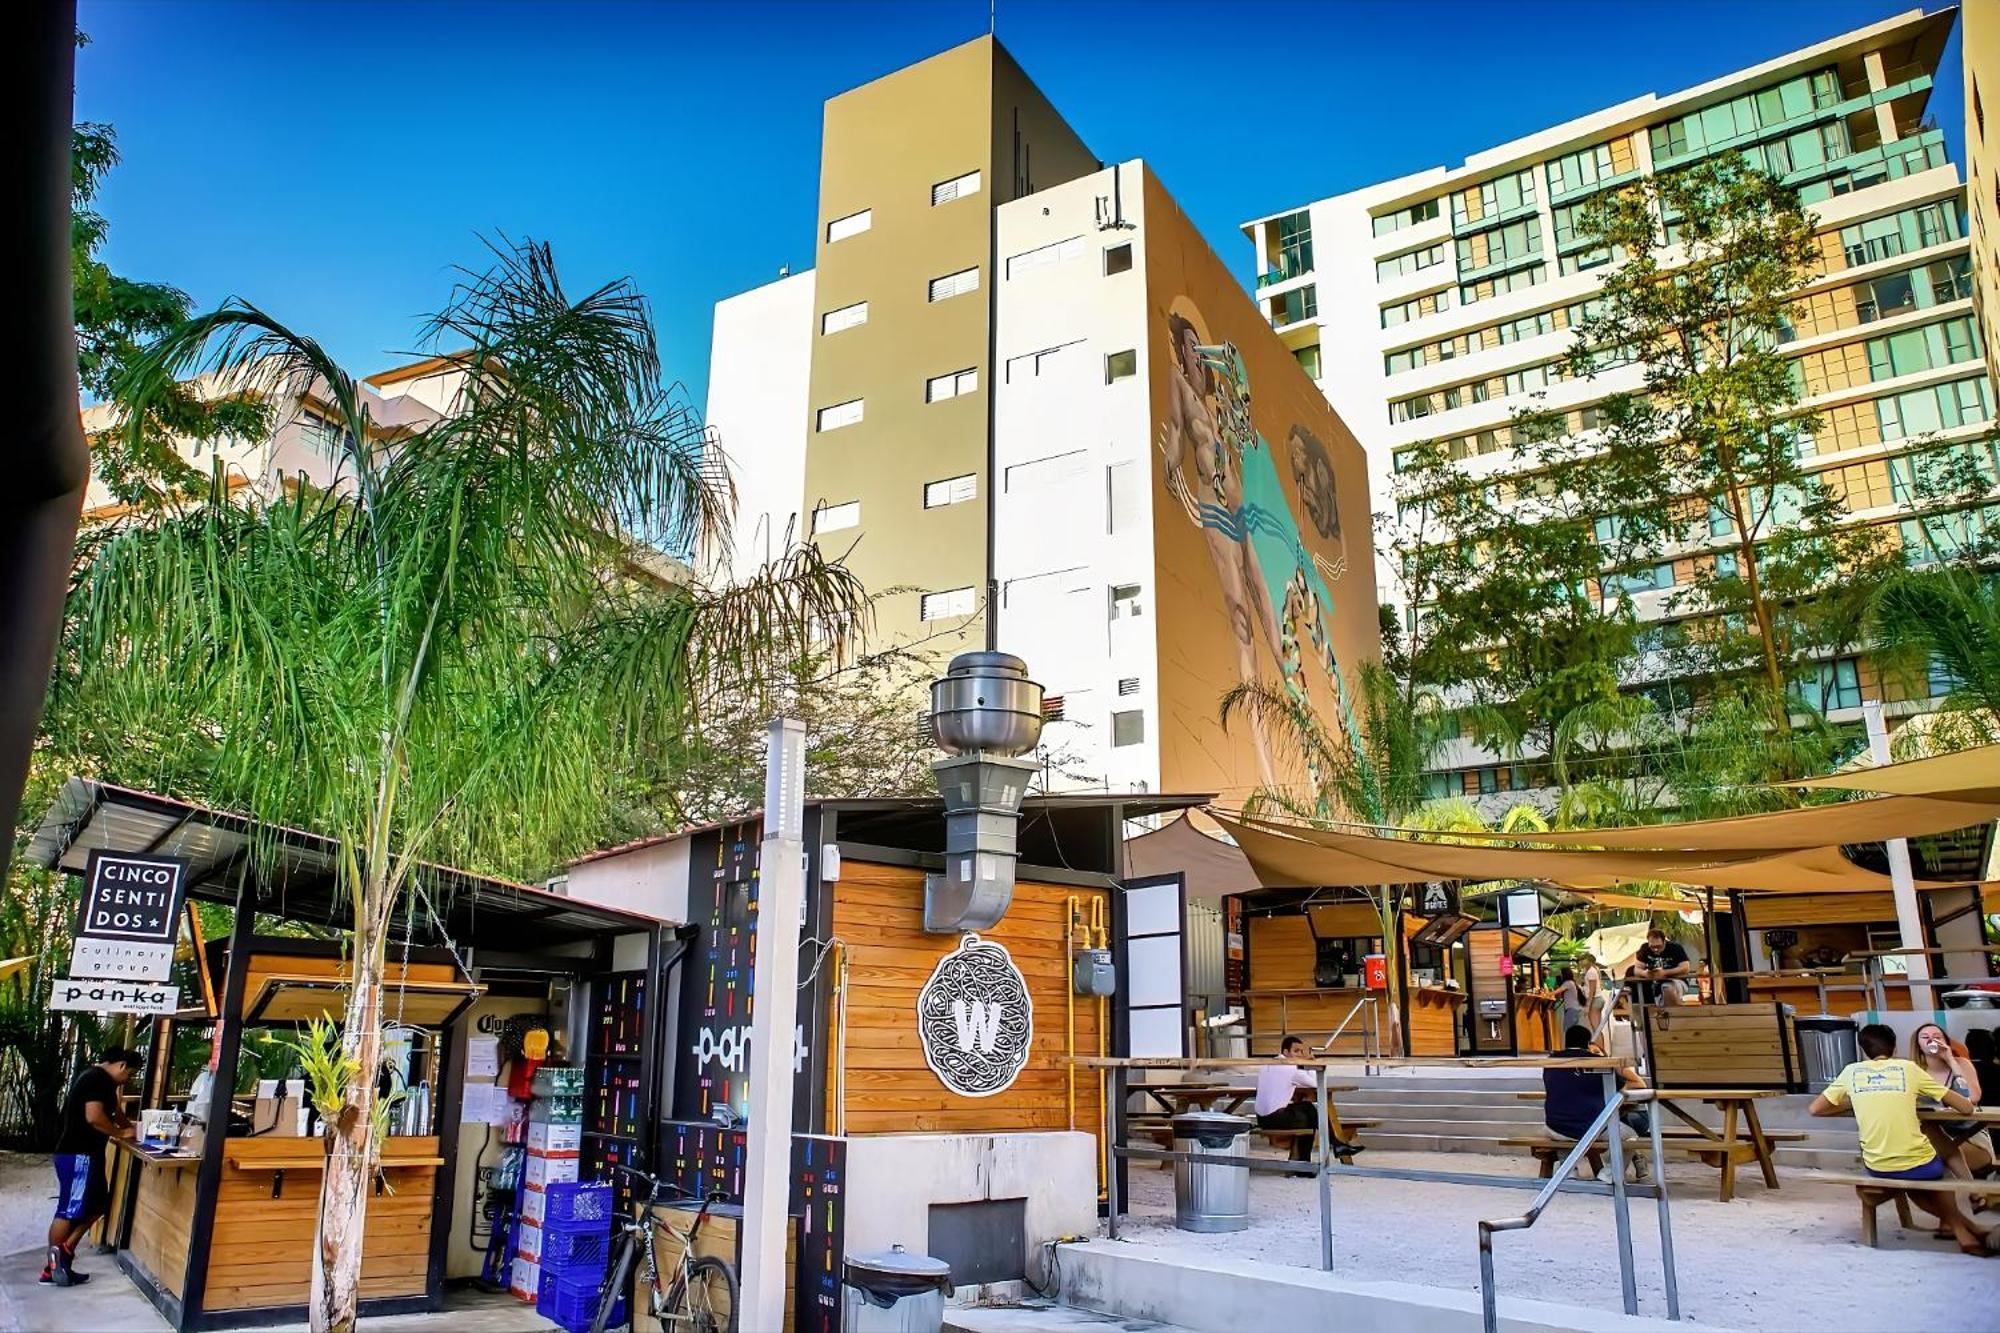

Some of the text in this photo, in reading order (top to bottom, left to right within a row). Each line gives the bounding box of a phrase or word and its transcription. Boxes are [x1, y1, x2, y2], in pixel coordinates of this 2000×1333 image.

[104, 865, 170, 884] CINCO
[100, 888, 165, 907] SENTI
[96, 911, 142, 928] DOS
[81, 947, 166, 958] culinary
[94, 963, 149, 973] group
[66, 987, 165, 1003] panka
[697, 1024, 805, 1076] pana
